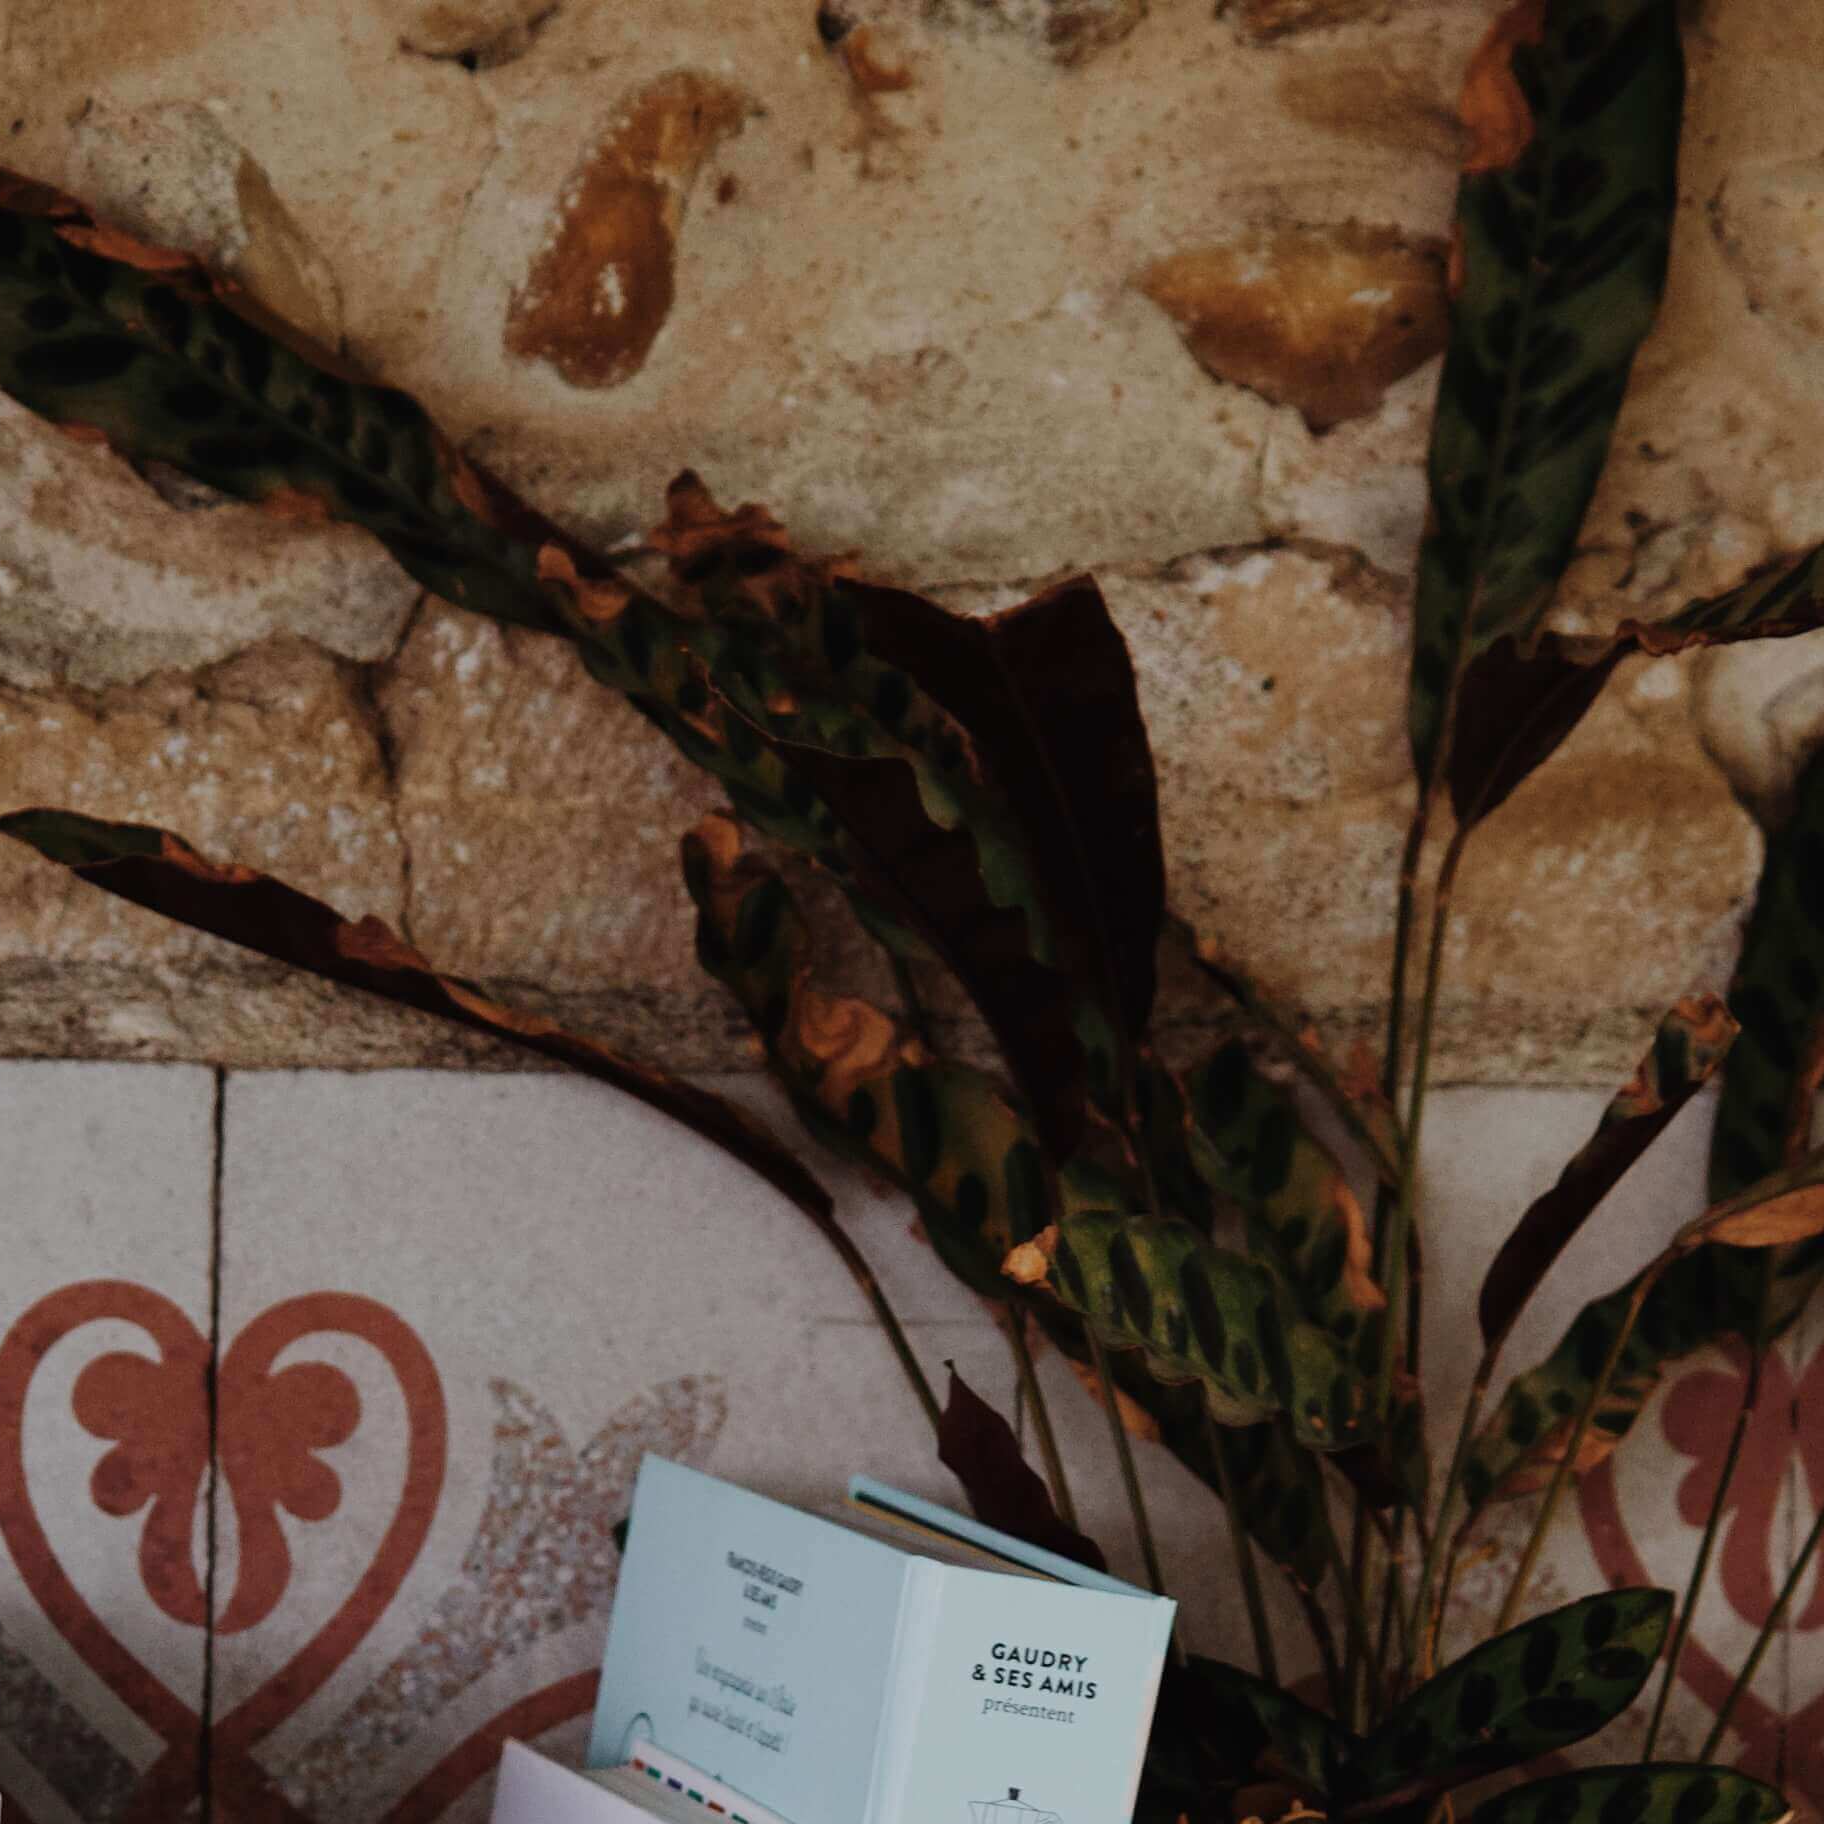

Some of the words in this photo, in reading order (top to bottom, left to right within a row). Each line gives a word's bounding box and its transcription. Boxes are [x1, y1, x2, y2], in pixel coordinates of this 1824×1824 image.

[991, 1643, 1088, 1673] GAUDRY
[972, 1664, 986, 1681] &
[993, 1667, 1033, 1688] SES
[1039, 1676, 1097, 1699] AMIS
[981, 1698, 1075, 1723] présentent
